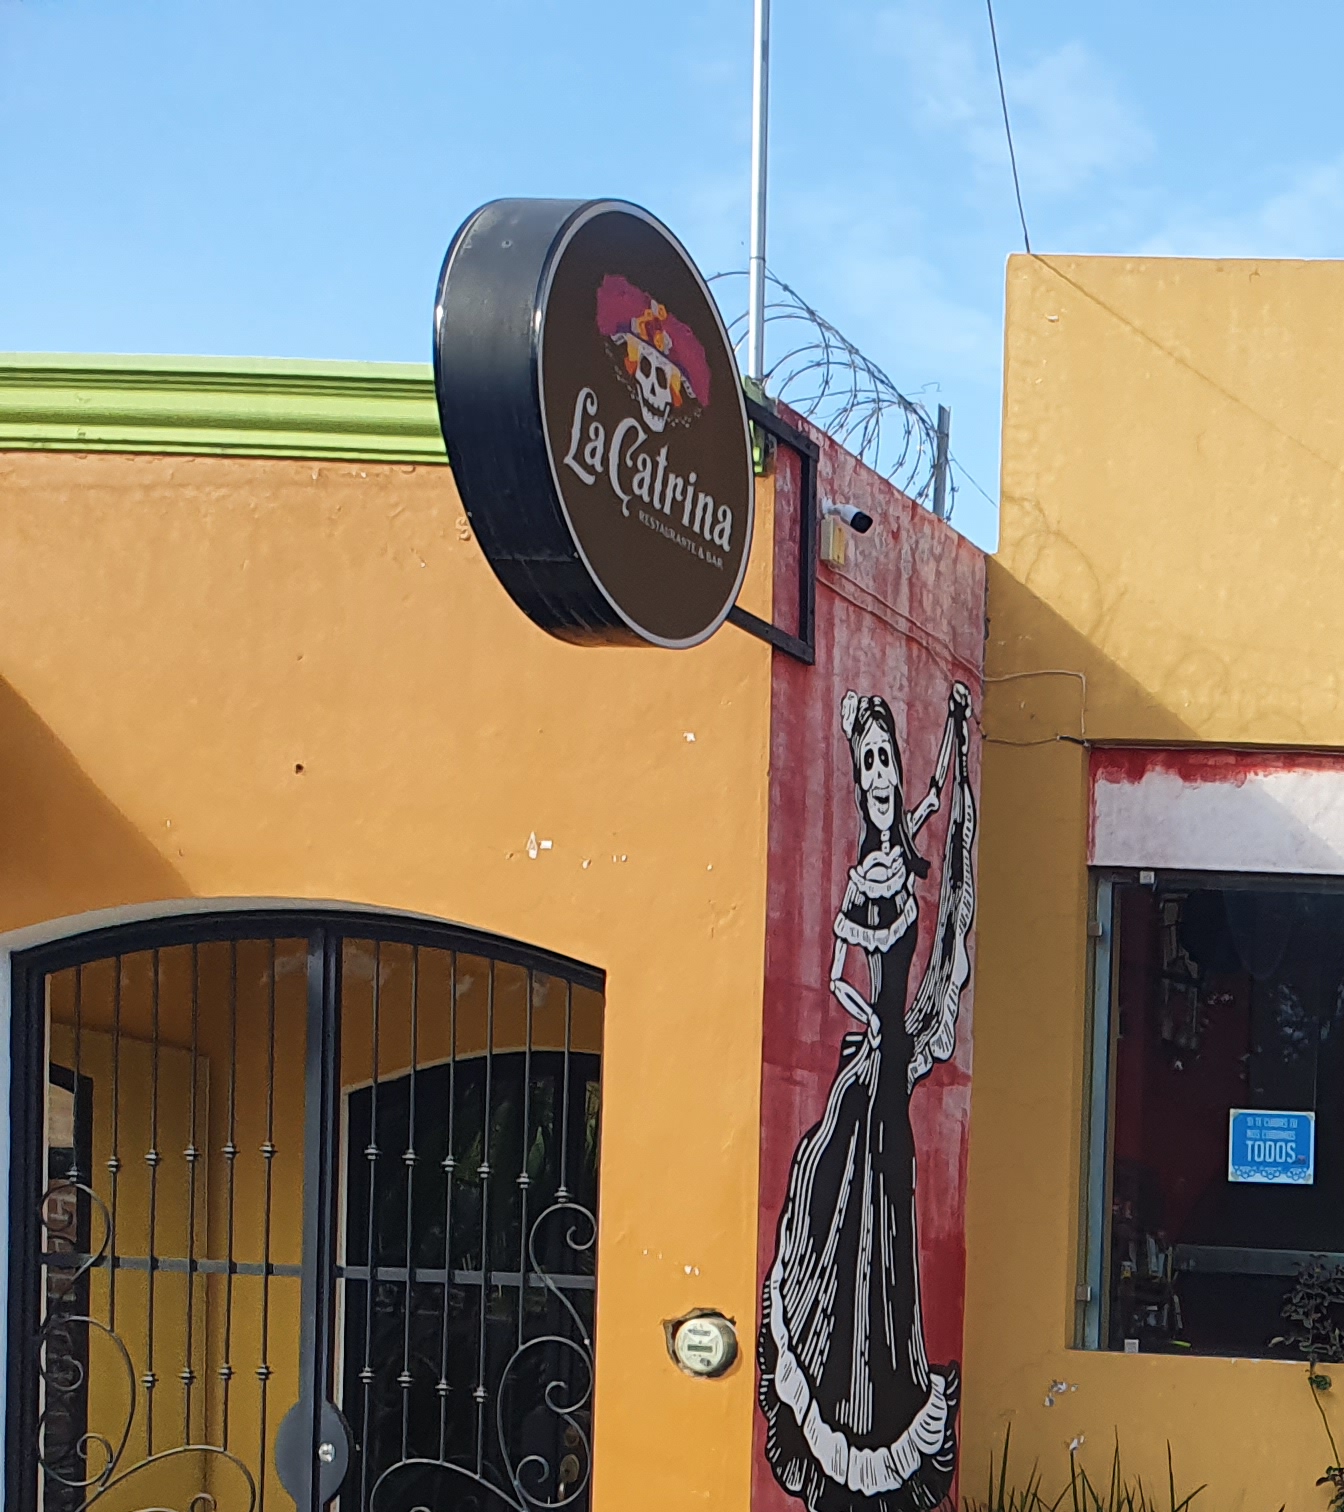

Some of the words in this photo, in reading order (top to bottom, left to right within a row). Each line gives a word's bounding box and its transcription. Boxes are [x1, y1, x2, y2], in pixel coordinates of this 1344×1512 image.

[564, 387, 604, 485] La
[608, 417, 733, 553] Catrina
[638, 509, 697, 555] RESTAURANTE
[705, 551, 723, 571] BAR
[1245, 1140, 1296, 1163] TODOS
